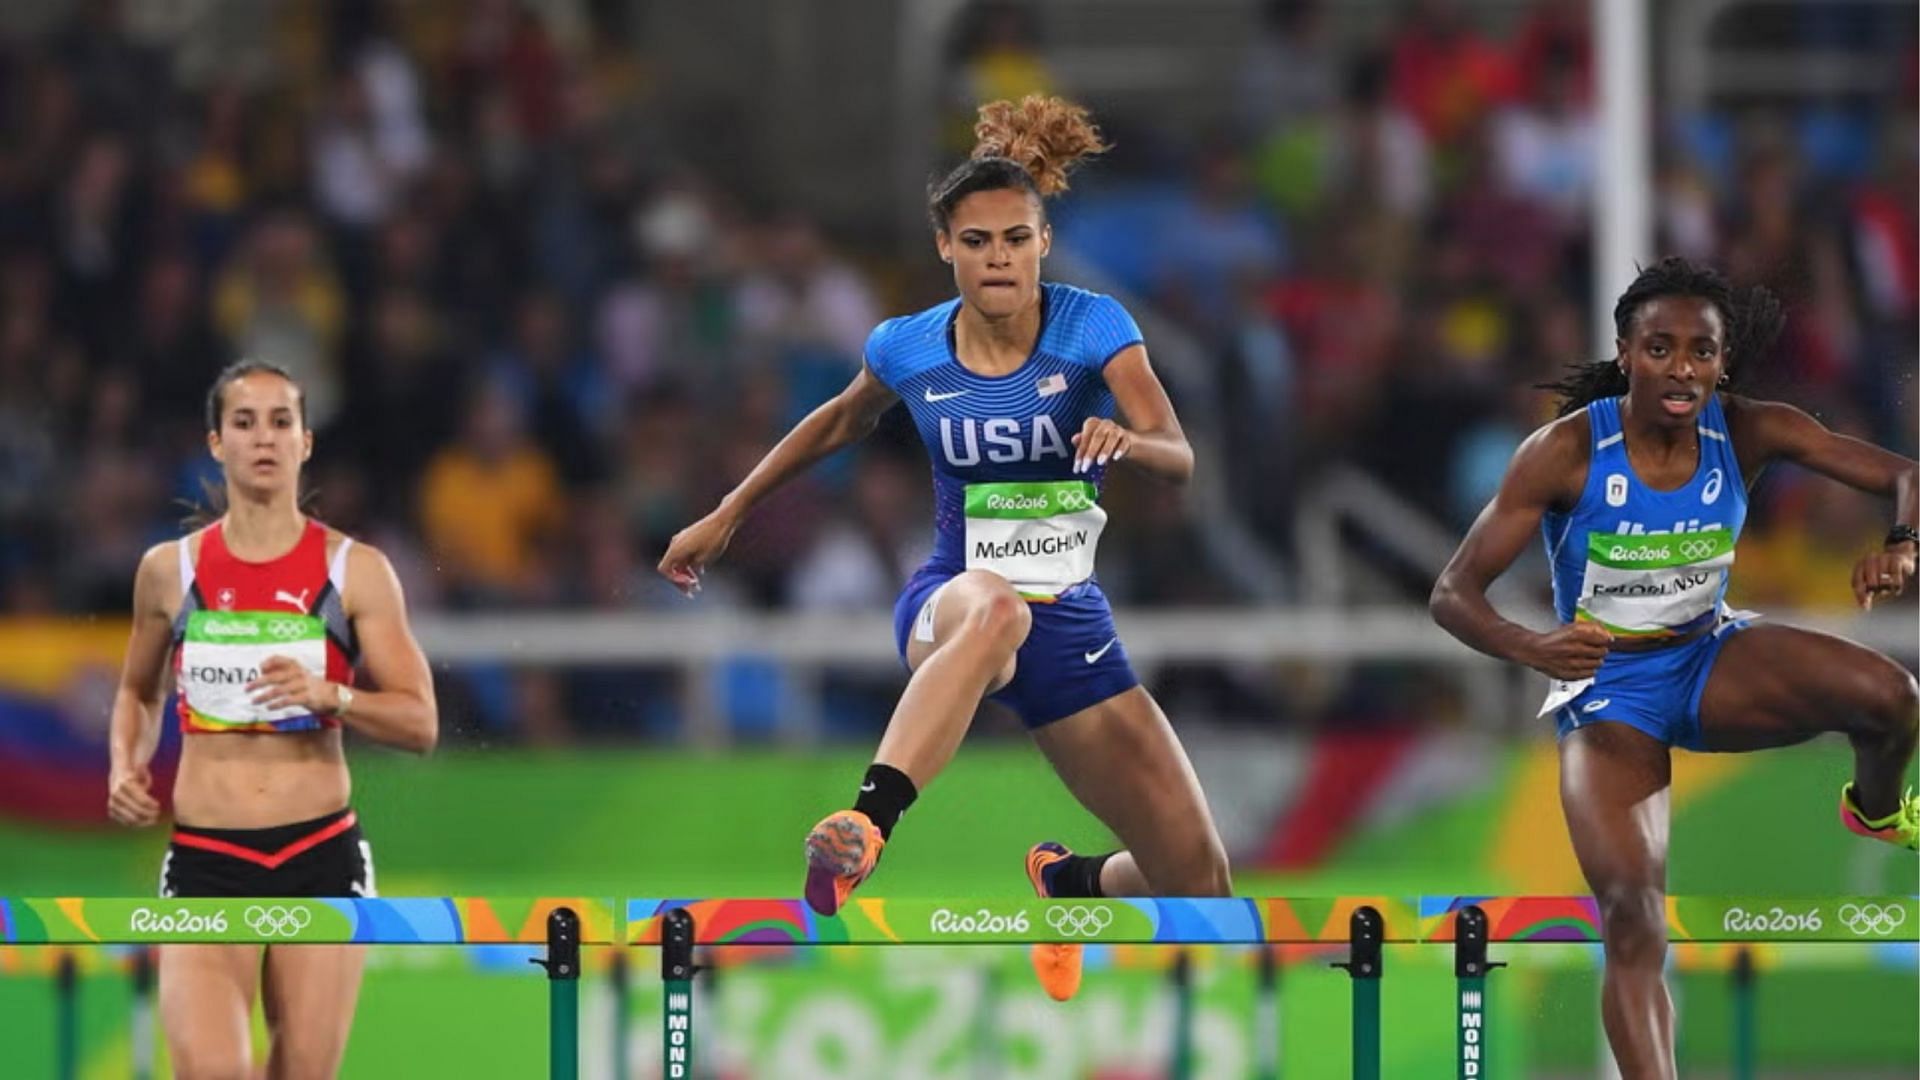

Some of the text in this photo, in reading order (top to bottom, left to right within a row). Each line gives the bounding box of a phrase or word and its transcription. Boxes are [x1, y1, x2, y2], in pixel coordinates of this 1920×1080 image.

[940, 414, 1068, 466] USA
[987, 493, 1049, 510] Rio2016
[975, 530, 1087, 559] McLAUGHLIN
[1609, 545, 1671, 561] Rio2016
[191, 666, 258, 684] FONTA
[131, 908, 229, 933] Rio2016
[930, 908, 1030, 933] Rio2016
[1723, 907, 1823, 932] Rio2016
[1462, 1013, 1481, 1080] MOND
